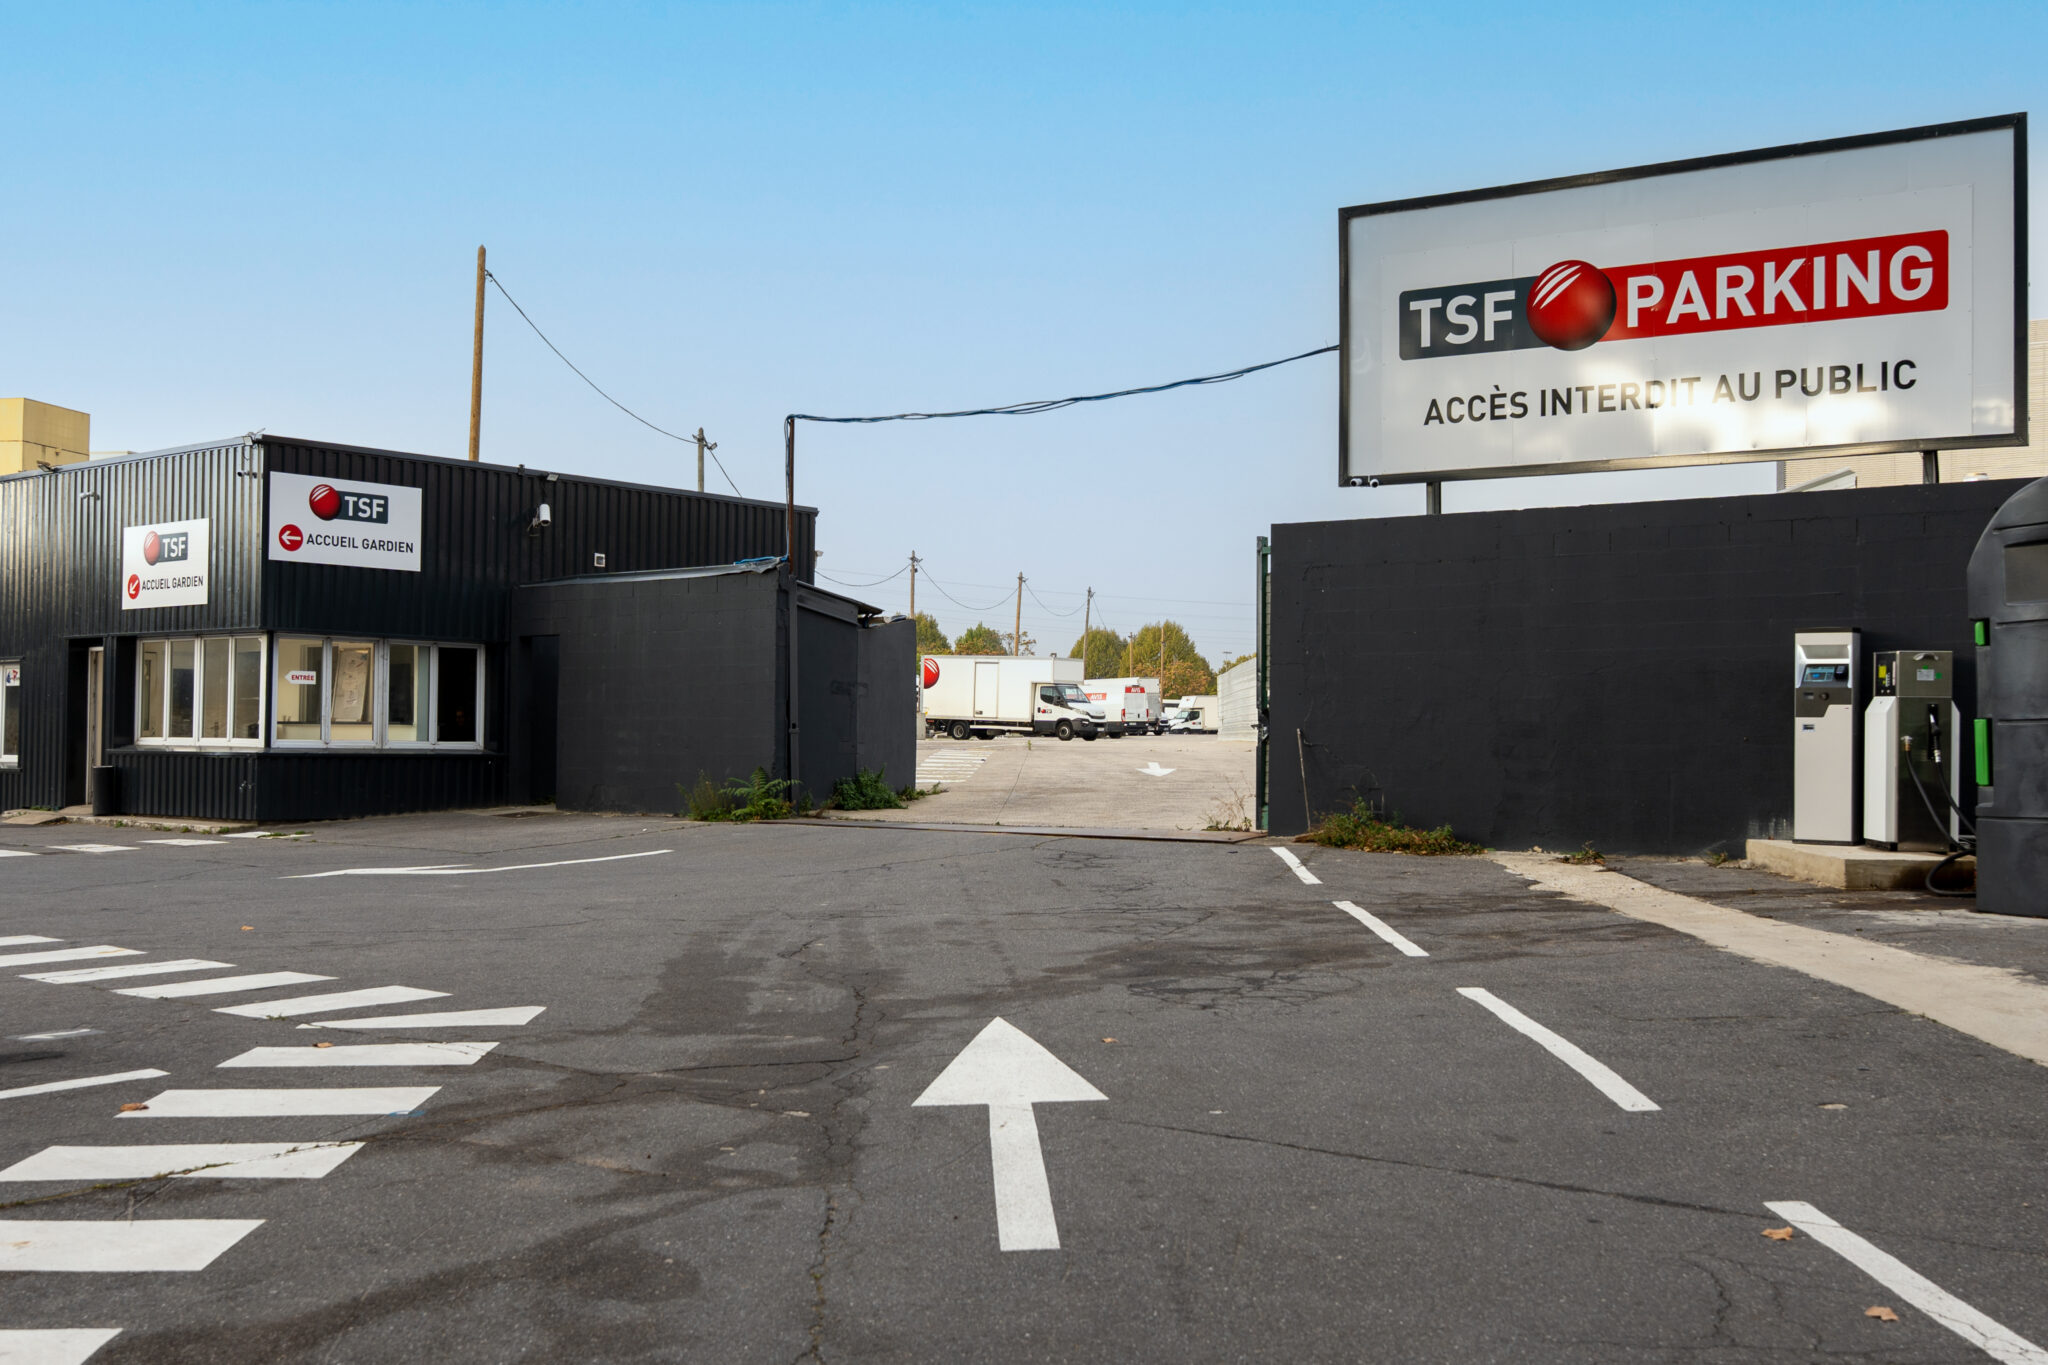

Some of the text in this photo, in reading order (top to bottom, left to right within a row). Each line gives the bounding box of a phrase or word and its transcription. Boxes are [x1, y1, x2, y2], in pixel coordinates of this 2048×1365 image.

[1409, 245, 1934, 348] TSF PARKING
[1423, 359, 1917, 426] ACCÈS INTERDIT AU PUBLIC
[344, 495, 385, 519] TSF
[162, 536, 186, 558] TSF
[306, 533, 414, 554] ACCUEIL GARDIEN
[142, 575, 204, 591] ACCUEIL GARDIEN
